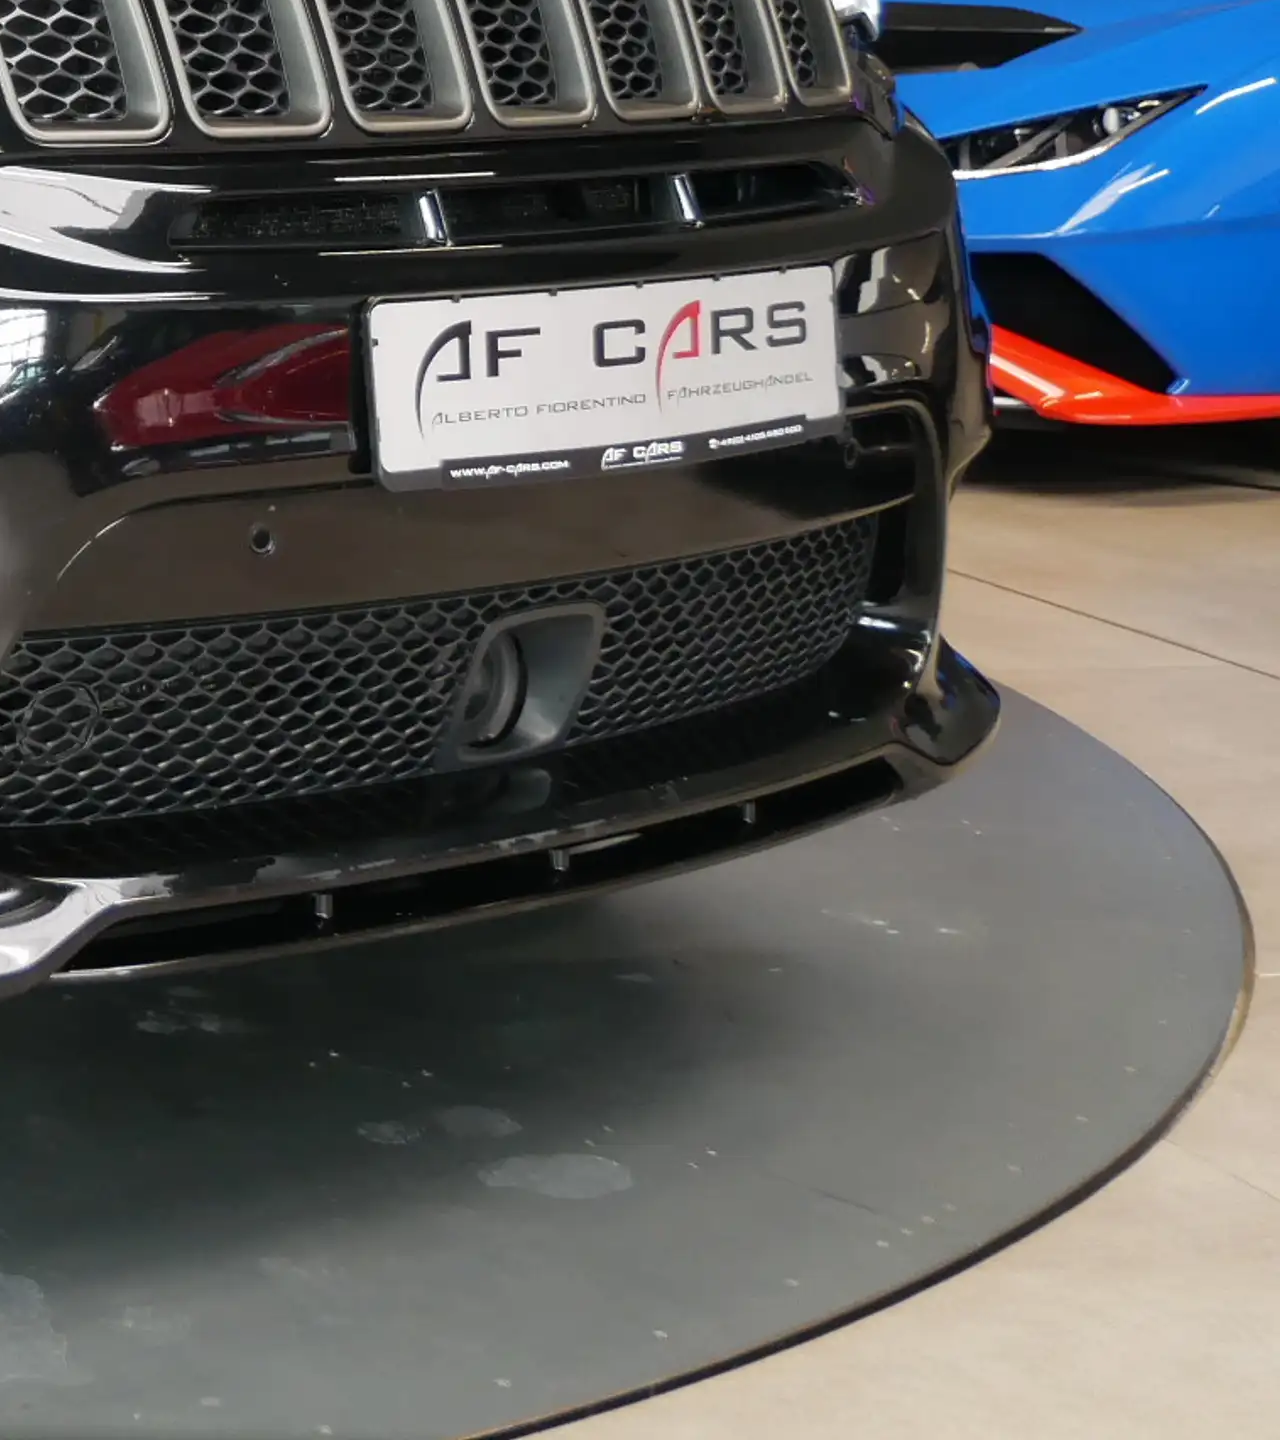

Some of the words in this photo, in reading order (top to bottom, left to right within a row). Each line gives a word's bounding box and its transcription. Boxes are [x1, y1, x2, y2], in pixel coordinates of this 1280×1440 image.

[415, 319, 541, 440] AF
[592, 299, 807, 415] CARS
[431, 404, 529, 430] ALBERTO
[536, 392, 647, 415] FIORENTINO
[666, 371, 814, 405] FAHRZEUGHANDEL
[601, 447, 627, 471] AF
[633, 441, 684, 464] CARS
